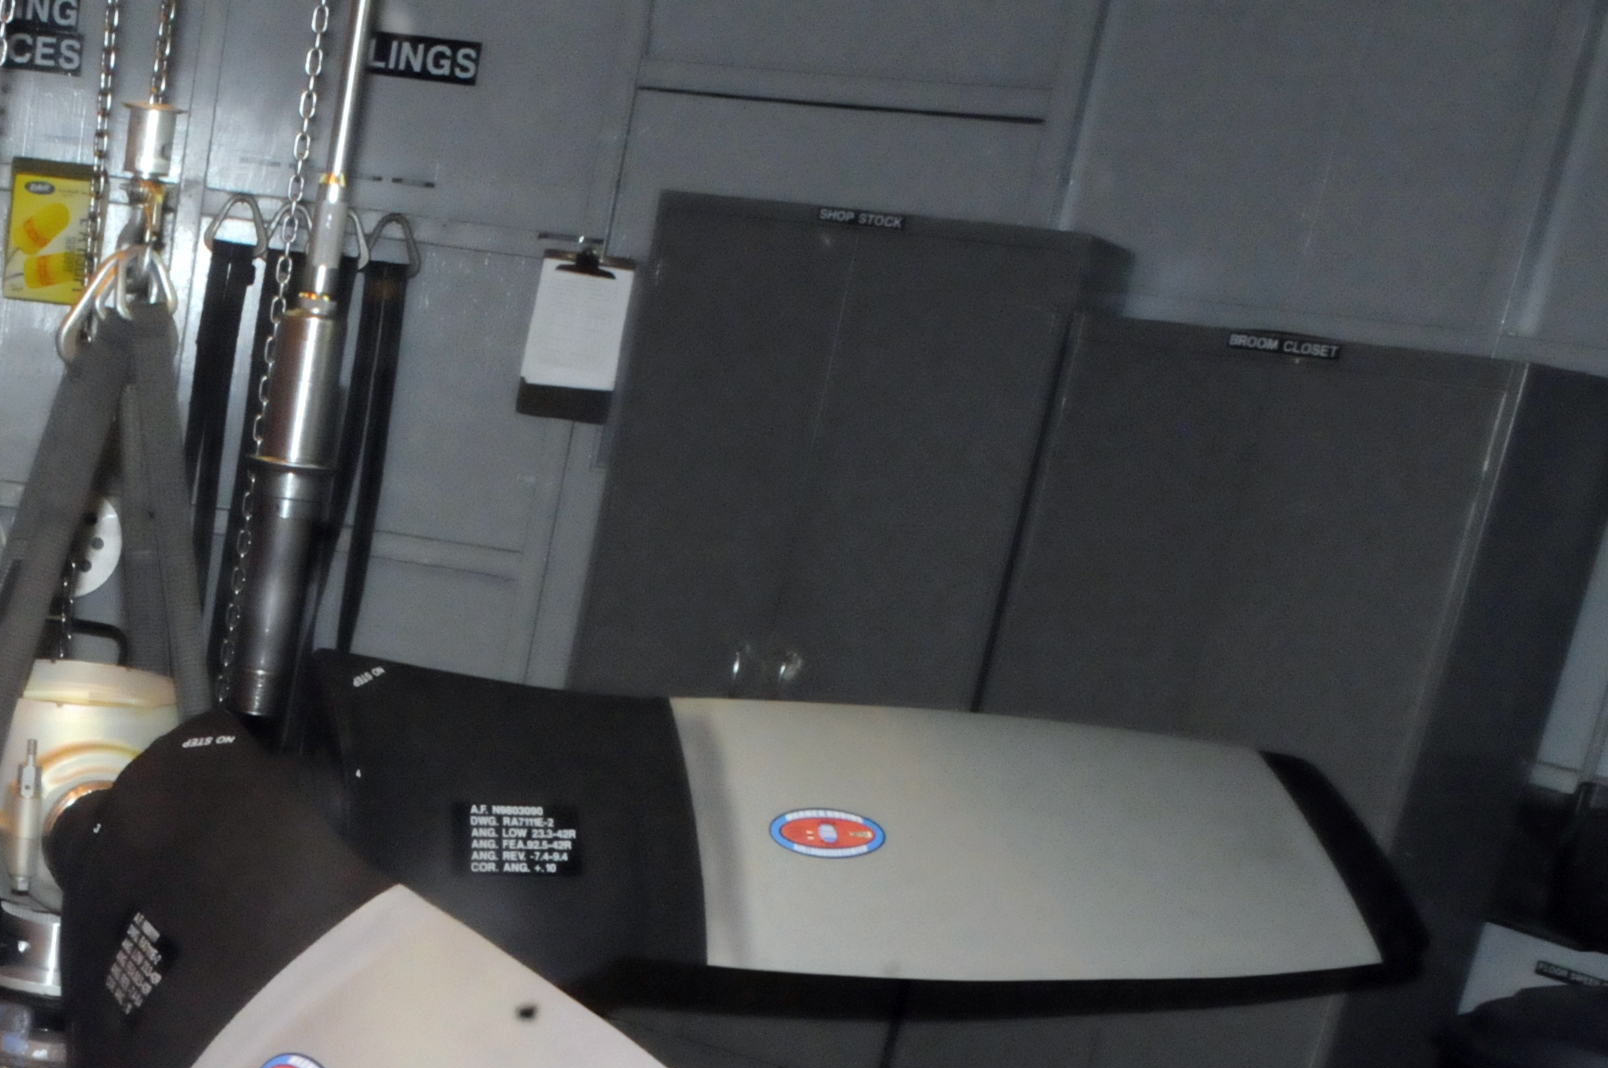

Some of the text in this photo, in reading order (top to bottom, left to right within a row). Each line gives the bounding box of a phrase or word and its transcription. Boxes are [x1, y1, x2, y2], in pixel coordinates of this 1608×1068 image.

[368, 38, 478, 79] LINGS
[819, 208, 903, 229] SHOP STOCK
[1229, 333, 1339, 358] BROOM CLOSET
[182, 735, 236, 748] NO STEP
[470, 816, 499, 826] DWG.
[471, 828, 498, 838] ANG.
[502, 828, 528, 838] LOW
[471, 839, 499, 849] ANG.
[471, 851, 499, 861] ANG.
[502, 851, 527, 861] REV.
[470, 862, 499, 873] COR.
[503, 862, 531, 873] ANG.
